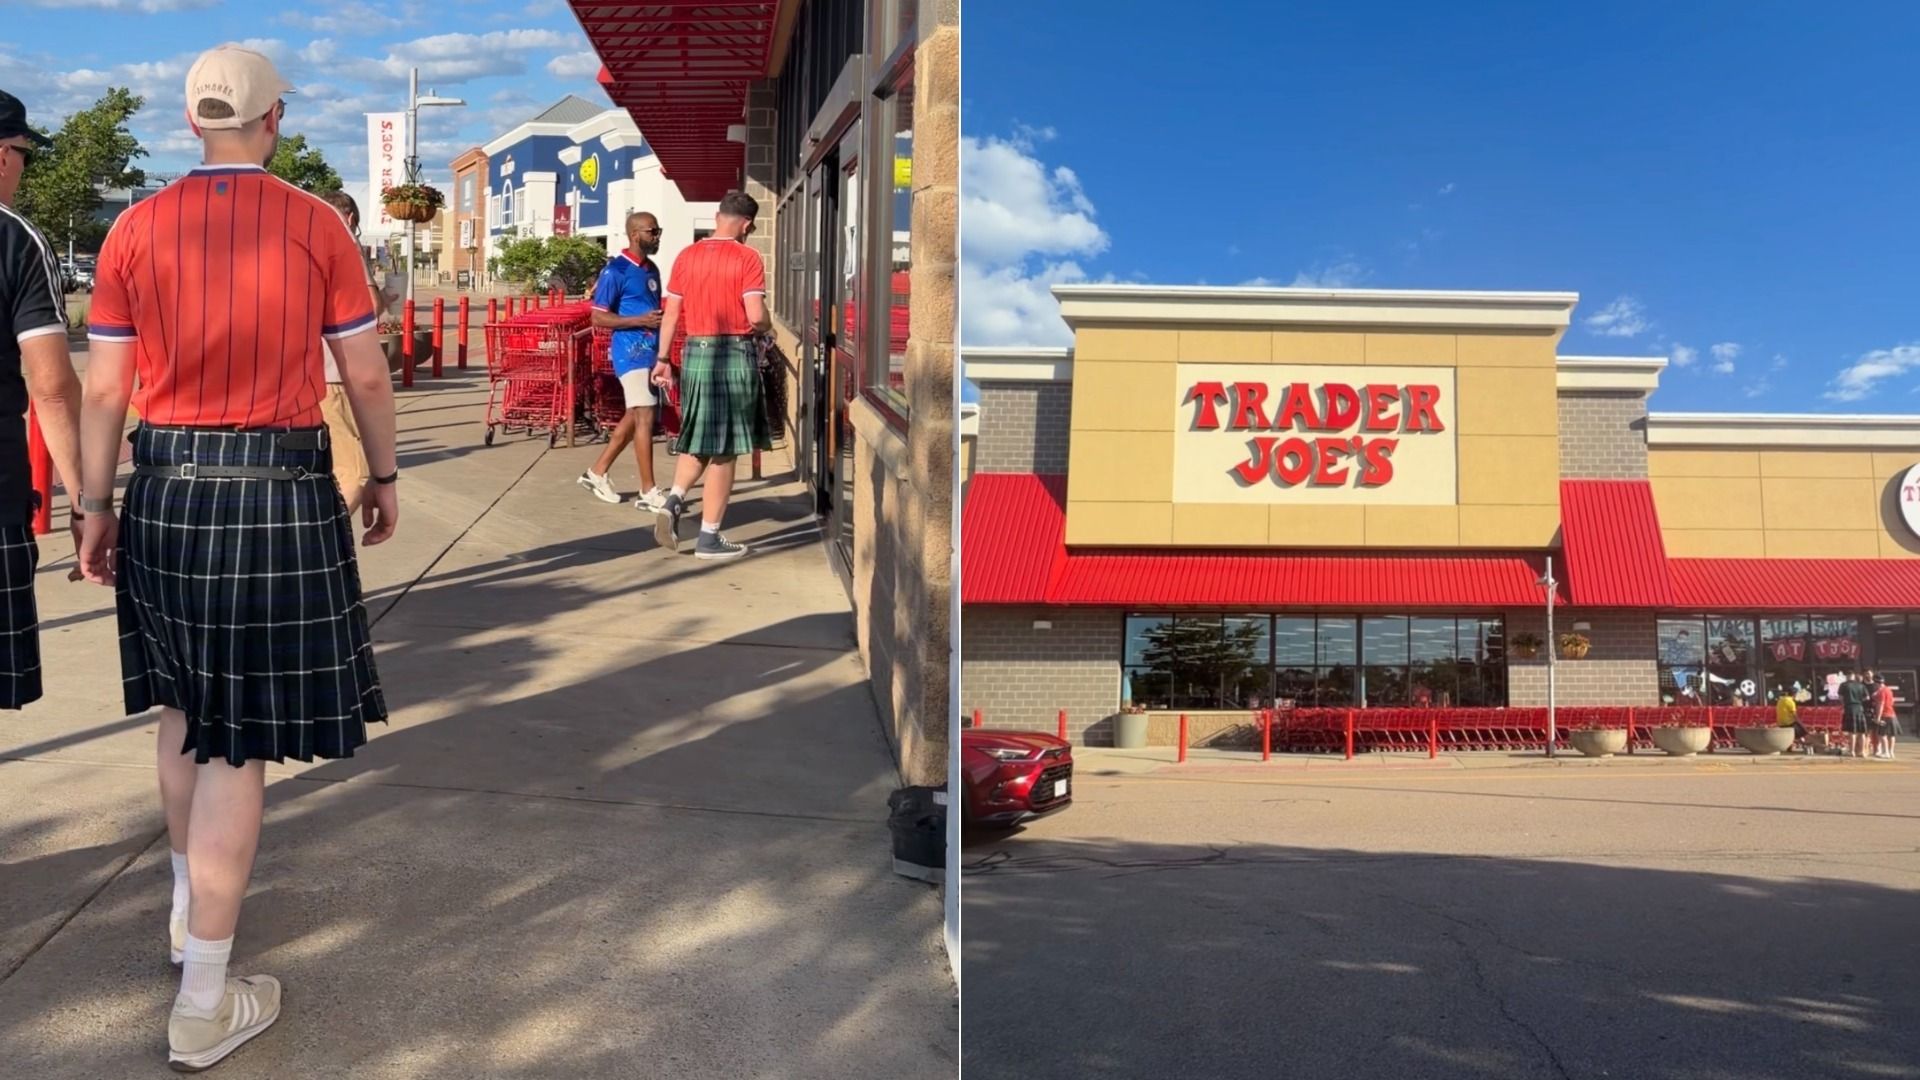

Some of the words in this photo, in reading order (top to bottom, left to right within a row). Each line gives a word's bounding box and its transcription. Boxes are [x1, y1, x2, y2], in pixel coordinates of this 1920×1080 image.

[381, 120, 393, 162] JOE'S
[381, 168, 393, 225] TER
[1190, 381, 1445, 432] TRADER
[1234, 435, 1400, 486] JOE'S
[1709, 619, 1754, 637] MAKE
[1766, 619, 1803, 637] THE
[1777, 642, 1801, 656] AT
[1816, 640, 1857, 658] TJS!
